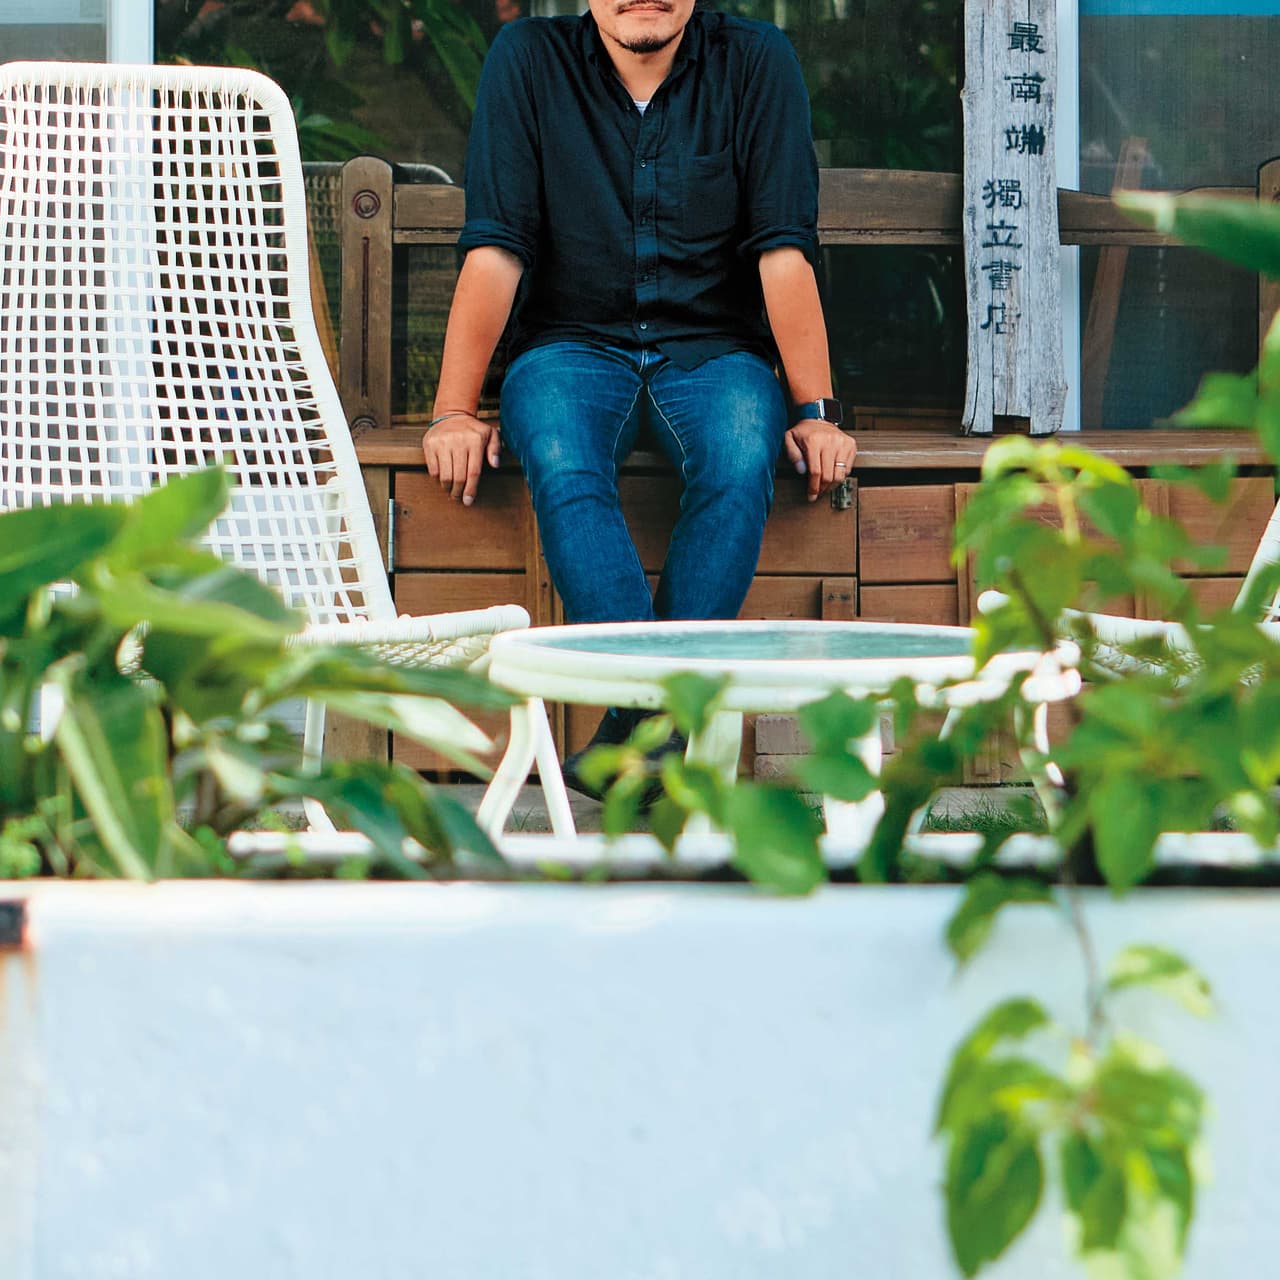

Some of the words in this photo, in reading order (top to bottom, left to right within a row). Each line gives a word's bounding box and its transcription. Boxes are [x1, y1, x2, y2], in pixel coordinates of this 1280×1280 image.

[1004, 22, 1045, 156] 最南端
[980, 179, 1023, 335] 獨立書店
